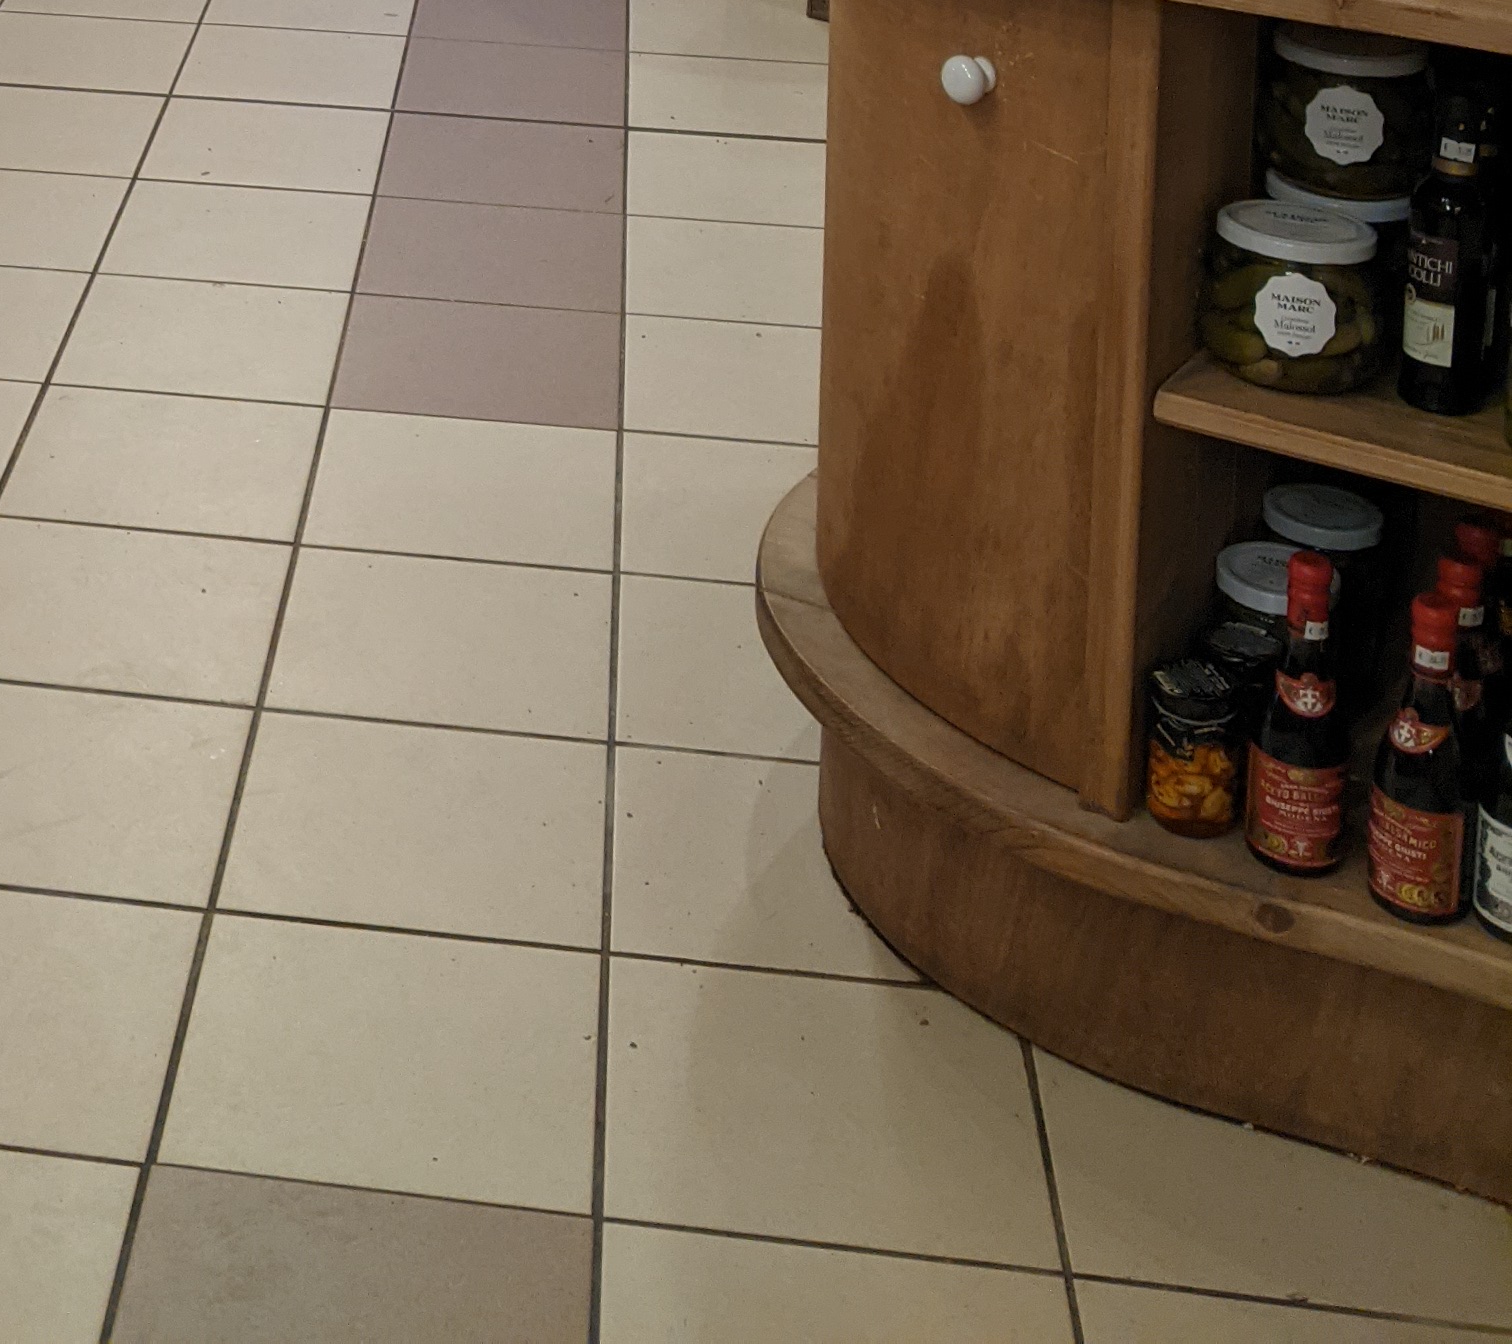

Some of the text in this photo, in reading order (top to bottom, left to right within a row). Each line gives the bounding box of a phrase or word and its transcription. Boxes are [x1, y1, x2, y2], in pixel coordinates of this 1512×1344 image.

[1320, 104, 1369, 118] MAISON
[1326, 112, 1361, 124] MARC
[1271, 292, 1322, 307] MAISON
[1277, 302, 1315, 313] MARC
[1274, 319, 1316, 333] Malossol
